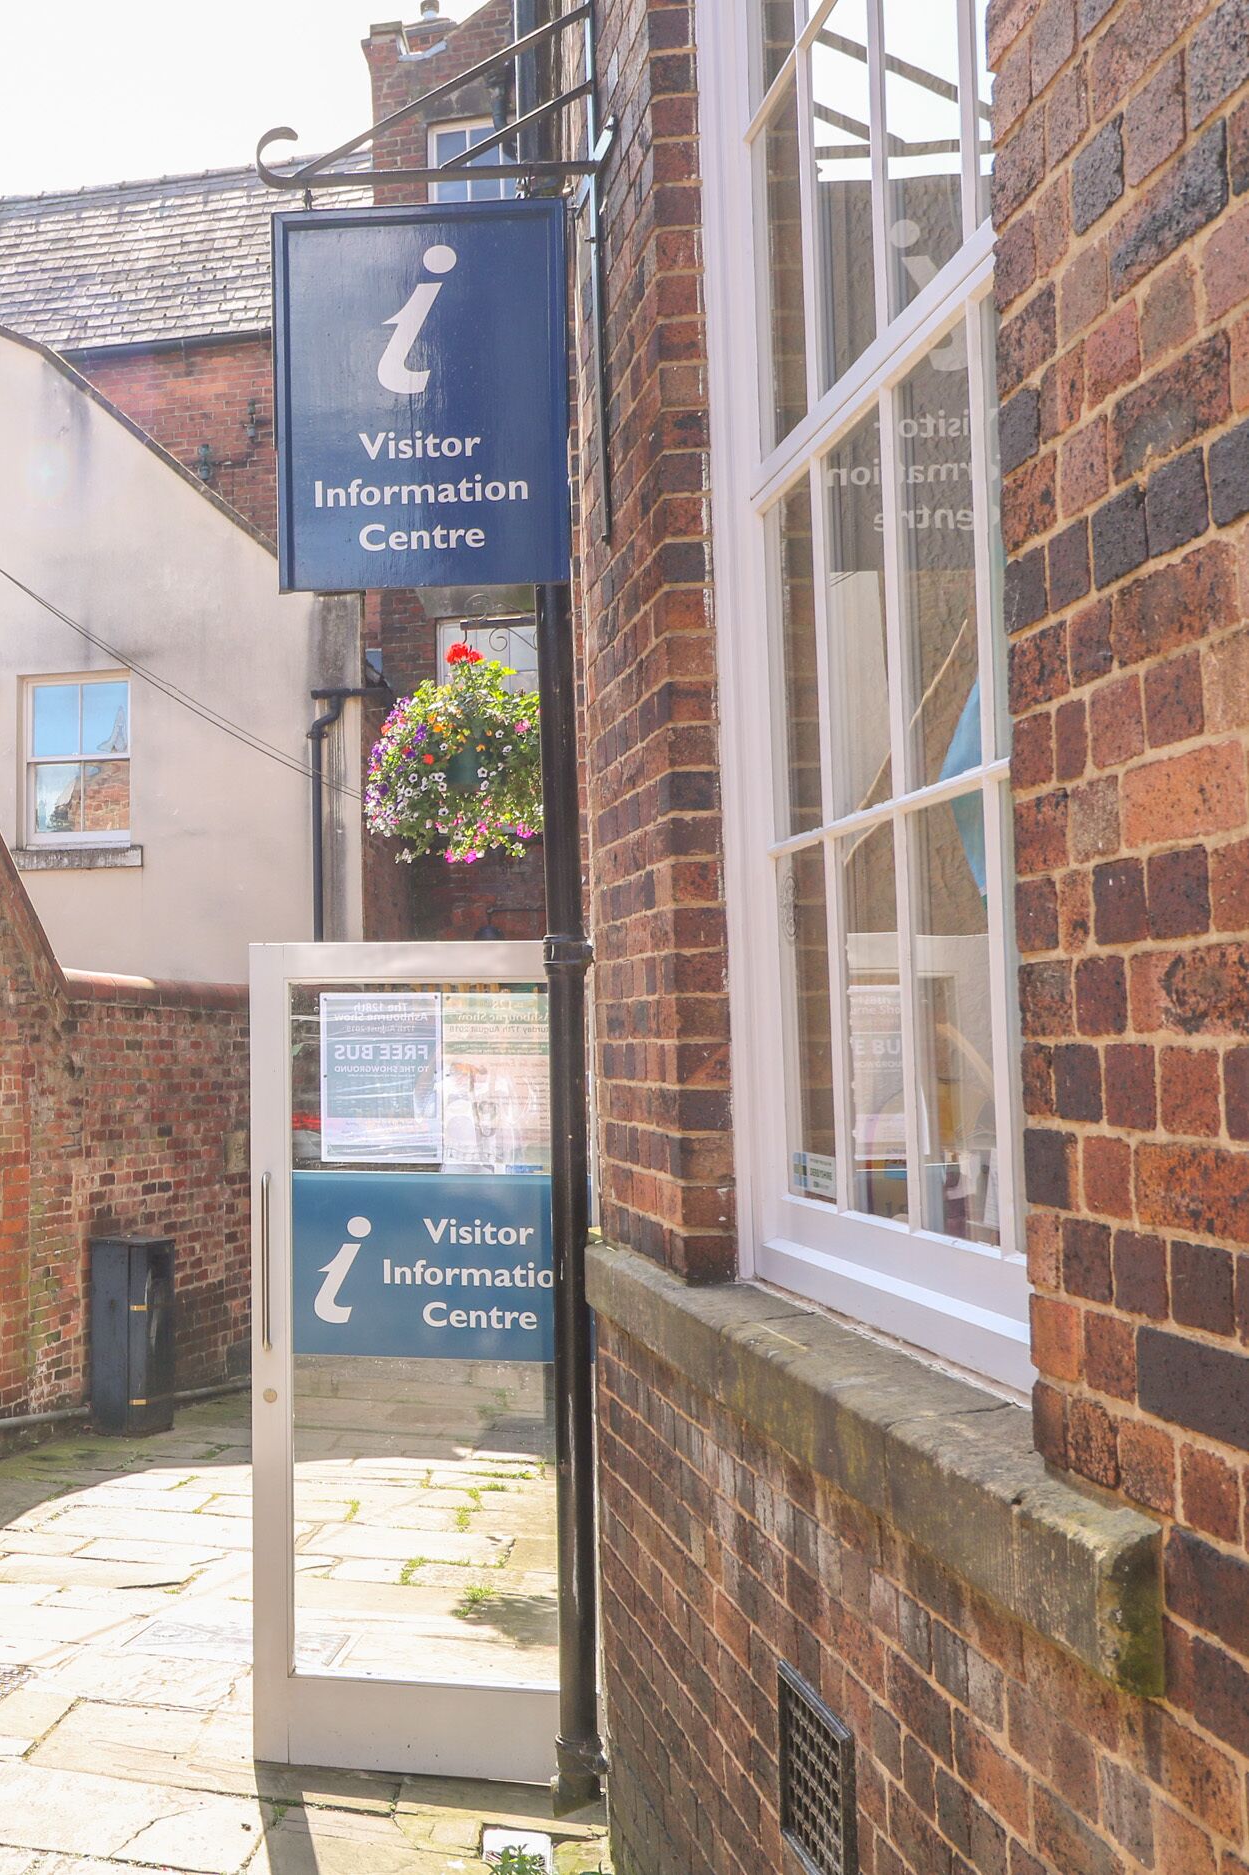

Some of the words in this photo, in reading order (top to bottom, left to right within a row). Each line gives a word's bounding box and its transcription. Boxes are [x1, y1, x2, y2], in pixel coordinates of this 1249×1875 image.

[358, 430, 481, 460] Visitor
[314, 474, 529, 508] Information
[358, 523, 486, 552] Centre
[880, 1005, 901, 1014] Sho
[873, 1040, 901, 1055] BU
[423, 1218, 534, 1246] Visitor
[383, 1259, 554, 1289] Informatio
[422, 1302, 538, 1330] Centre
